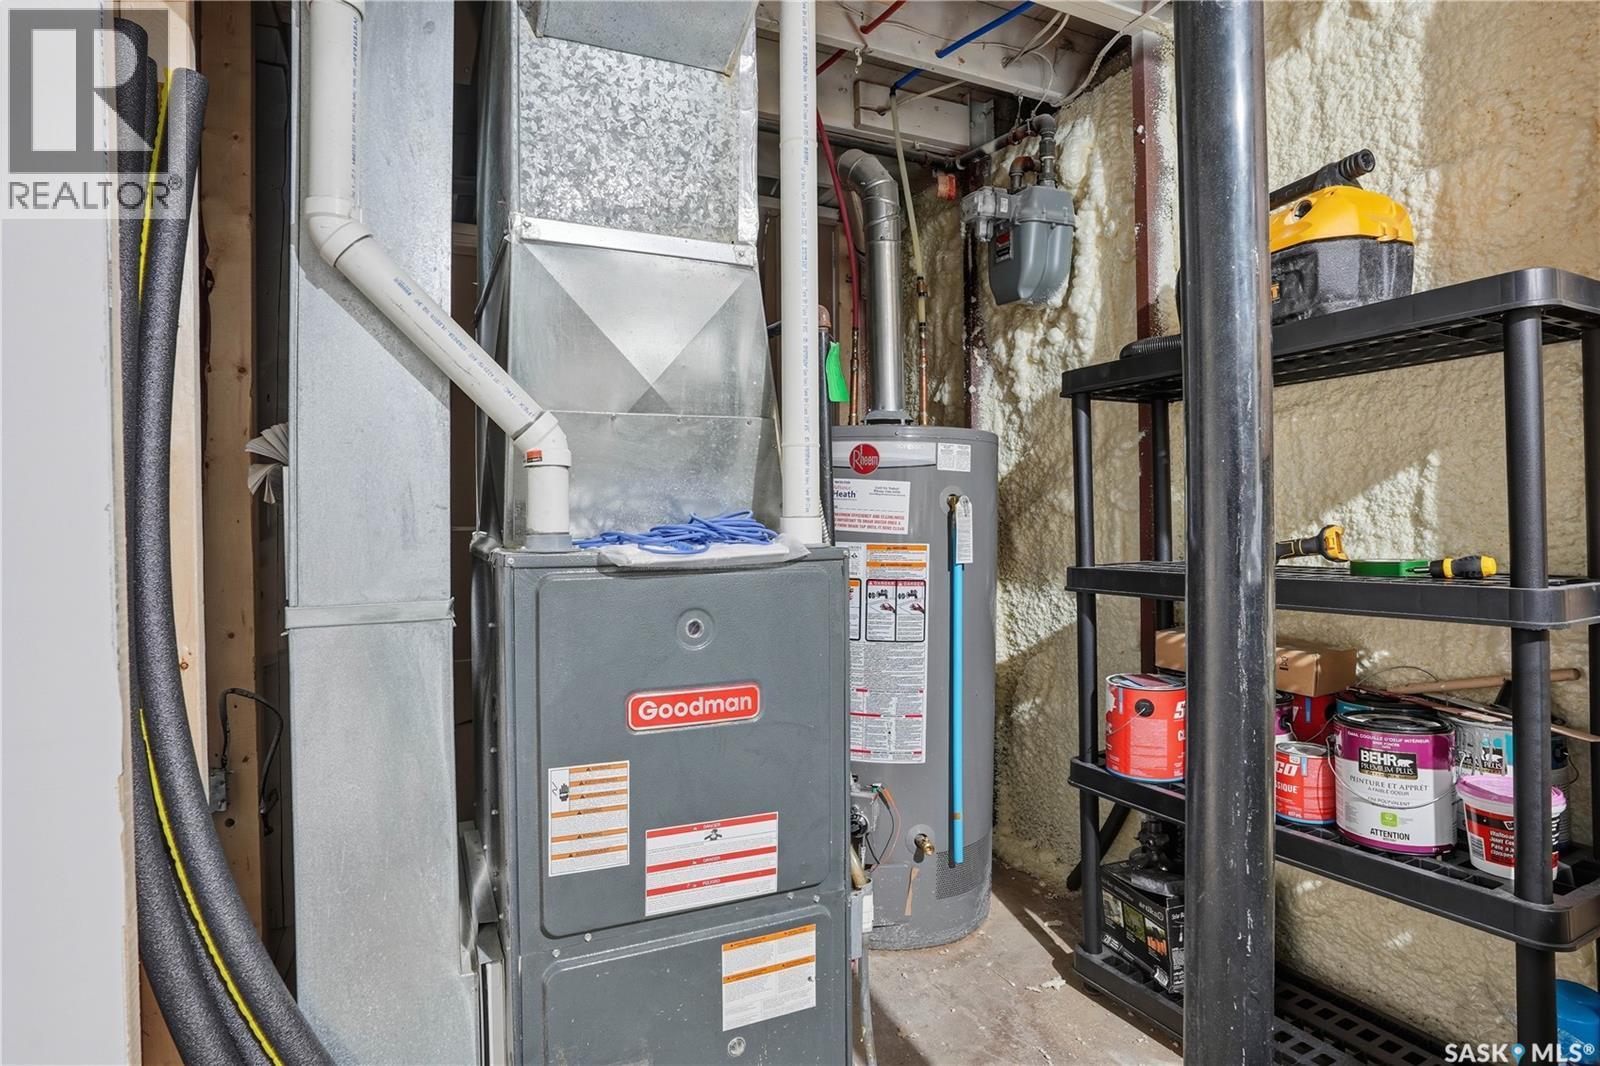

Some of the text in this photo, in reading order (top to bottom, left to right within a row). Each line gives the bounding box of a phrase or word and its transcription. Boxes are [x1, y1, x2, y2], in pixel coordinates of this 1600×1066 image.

[853, 445, 878, 469] Rheem
[638, 695, 752, 721] Goodman
[1360, 749, 1397, 767] BEHR
[1360, 762, 1414, 775] PREMIUM PLUS
[1350, 775, 1385, 788] PEINTURE
[1370, 828, 1410, 841] ATTENTION
